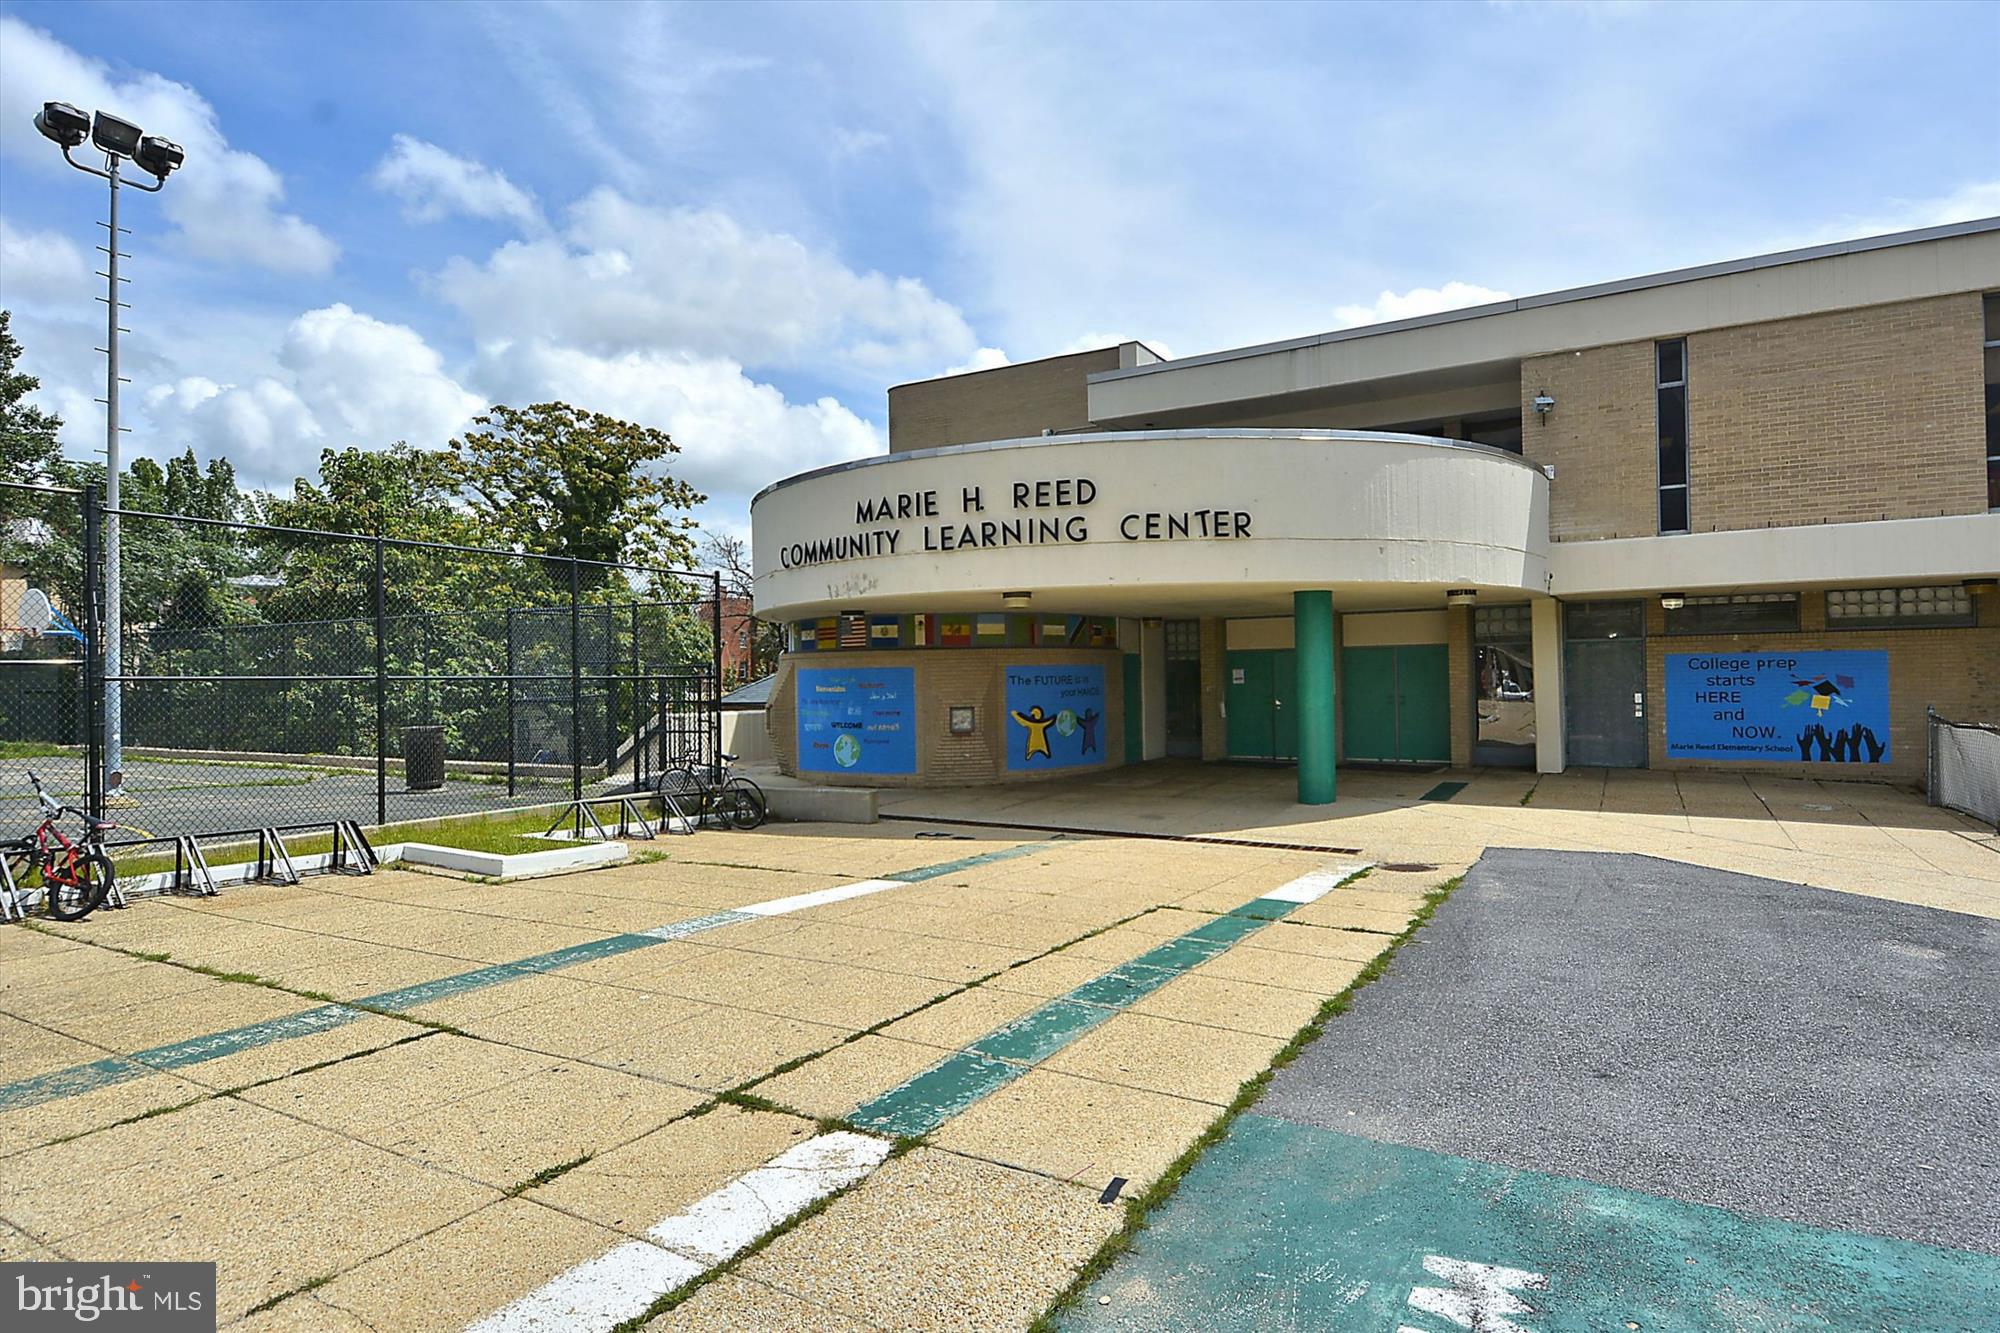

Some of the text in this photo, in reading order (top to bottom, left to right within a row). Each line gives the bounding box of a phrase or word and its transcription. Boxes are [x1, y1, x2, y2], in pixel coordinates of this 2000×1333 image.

[855, 477, 1097, 525] MARIE H. REED
[780, 508, 1253, 570] COMMUNITY LEARNING CENTER
[1688, 657, 1797, 672] College prep
[1008, 674, 1032, 685] The
[1034, 674, 1073, 686] FUTURE
[1706, 674, 1756, 687] starts
[1695, 691, 1741, 704] HERE
[1713, 708, 1745, 721] and
[831, 721, 864, 729] WELCOME
[1731, 725, 1783, 739] NOW.
[1671, 743, 1794, 753] Marie Reed Elementary School
